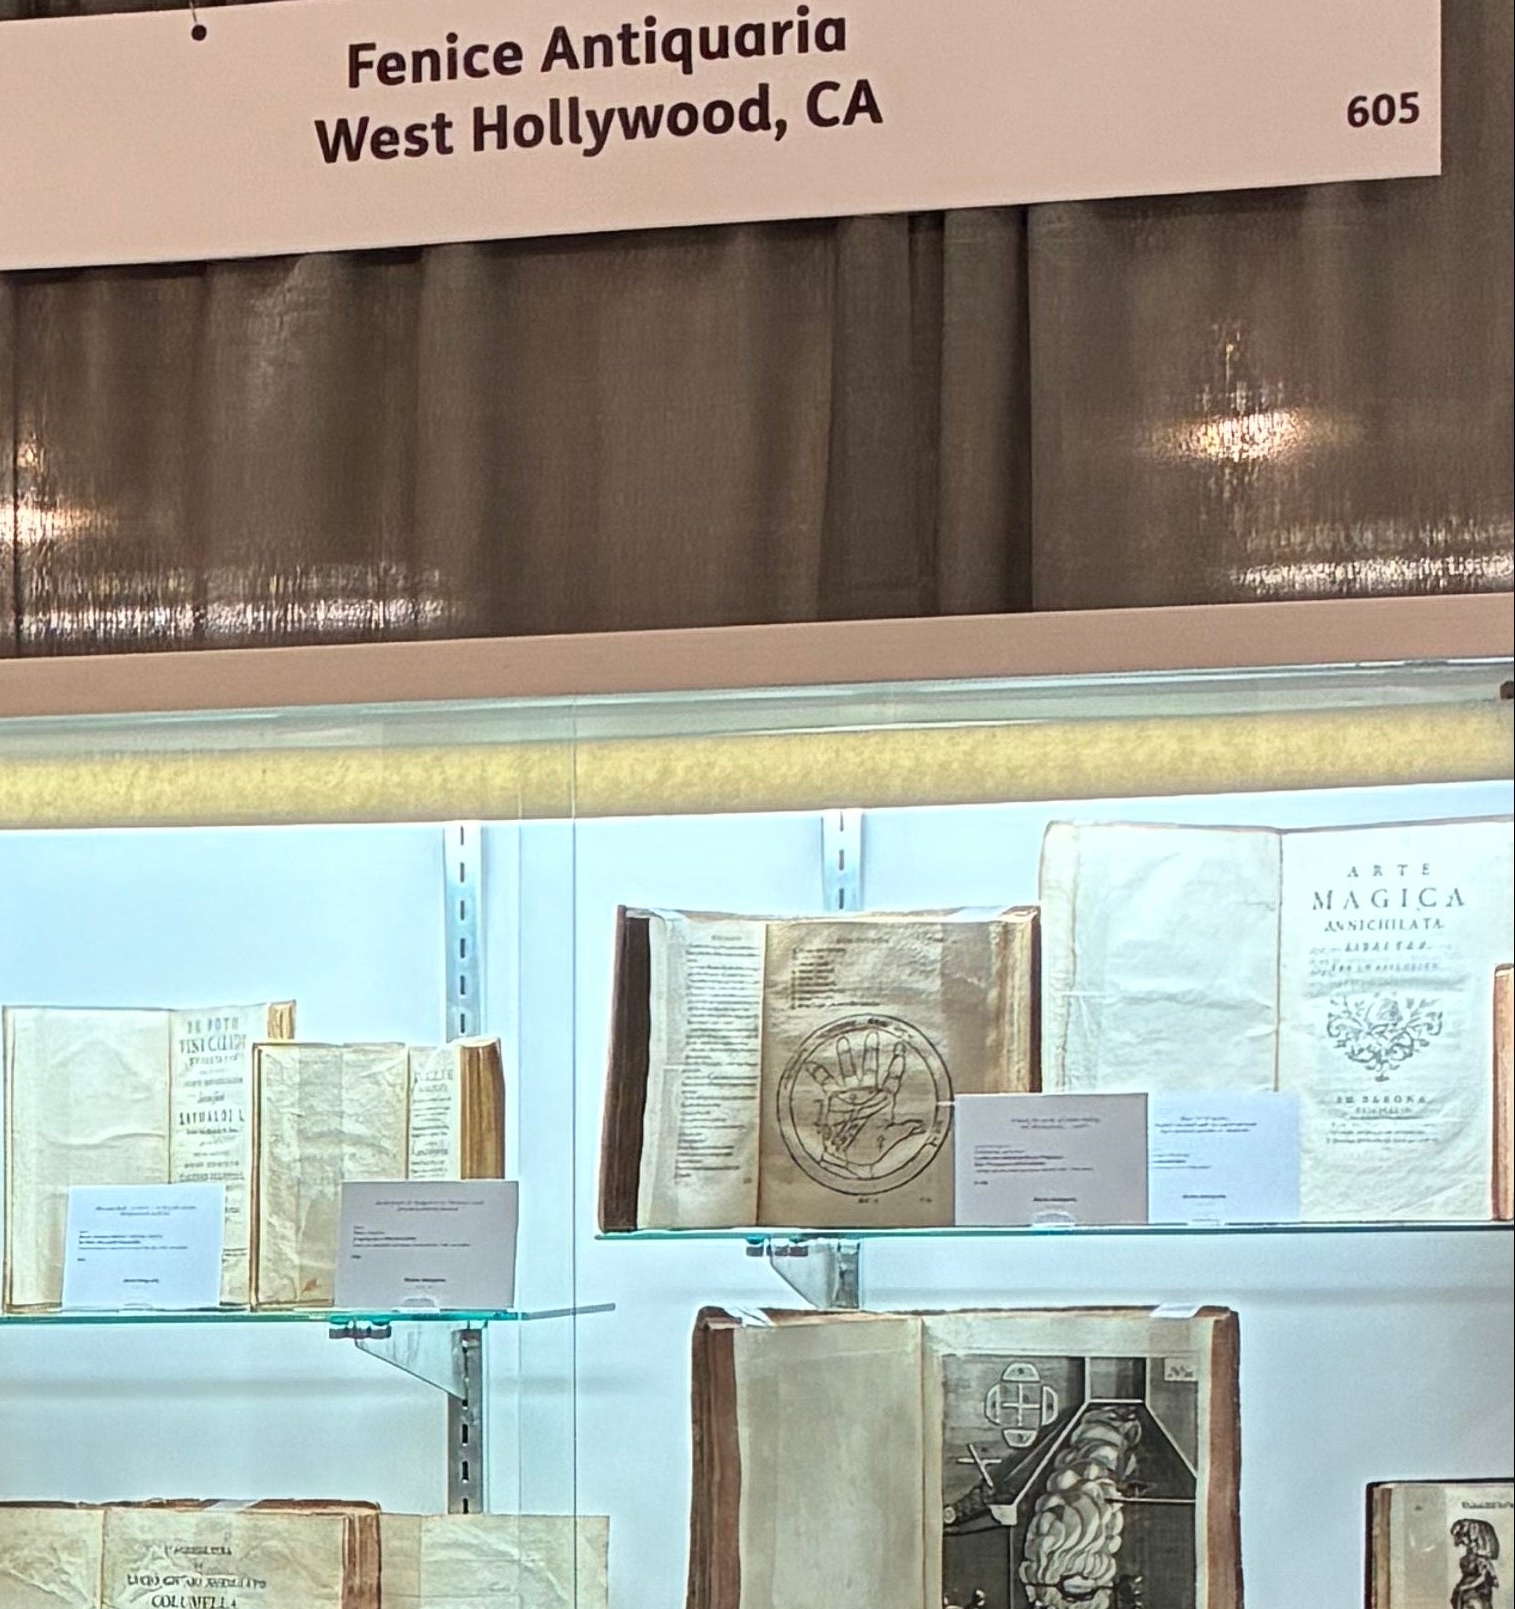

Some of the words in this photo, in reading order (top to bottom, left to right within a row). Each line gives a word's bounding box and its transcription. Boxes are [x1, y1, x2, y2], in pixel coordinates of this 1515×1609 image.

[347, 32, 524, 89] Fenice
[539, 4, 847, 75] Antiquaria
[314, 112, 454, 164] West
[472, 82, 788, 157] Hollywood,
[805, 79, 884, 127] CA
[1346, 91, 1420, 128] 605
[1346, 863, 1431, 878] ARTE
[1312, 887, 1465, 911] MAGICA
